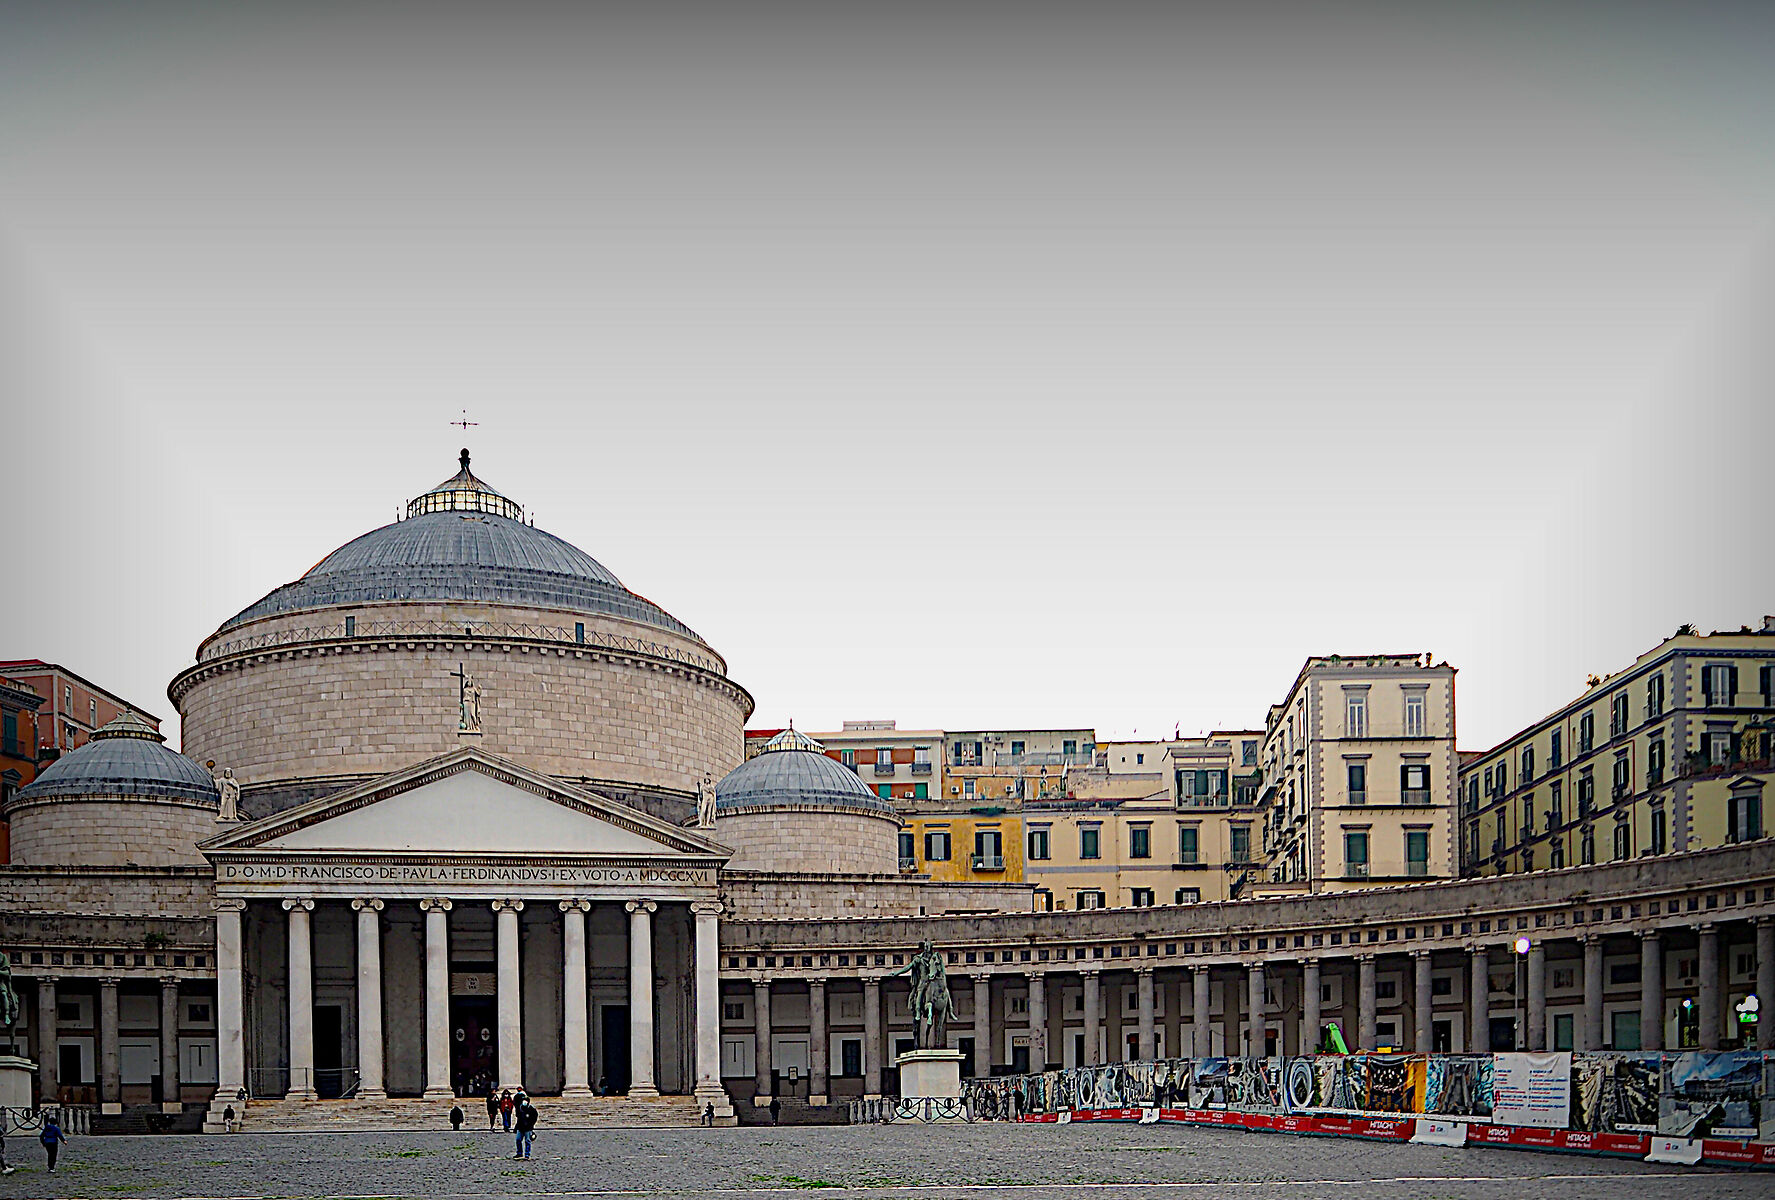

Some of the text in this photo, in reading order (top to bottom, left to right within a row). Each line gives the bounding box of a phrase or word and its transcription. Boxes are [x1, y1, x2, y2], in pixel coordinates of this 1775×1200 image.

[292, 866, 374, 879] FRANCISCO
[379, 866, 398, 879] DE
[402, 867, 448, 879] PAVLA
[453, 868, 548, 880] FERDINANDVS
[559, 869, 577, 881] EX
[582, 869, 621, 882] VOTO
[624, 870, 635, 881] A
[1567, 1133, 1591, 1142] HITACHI
